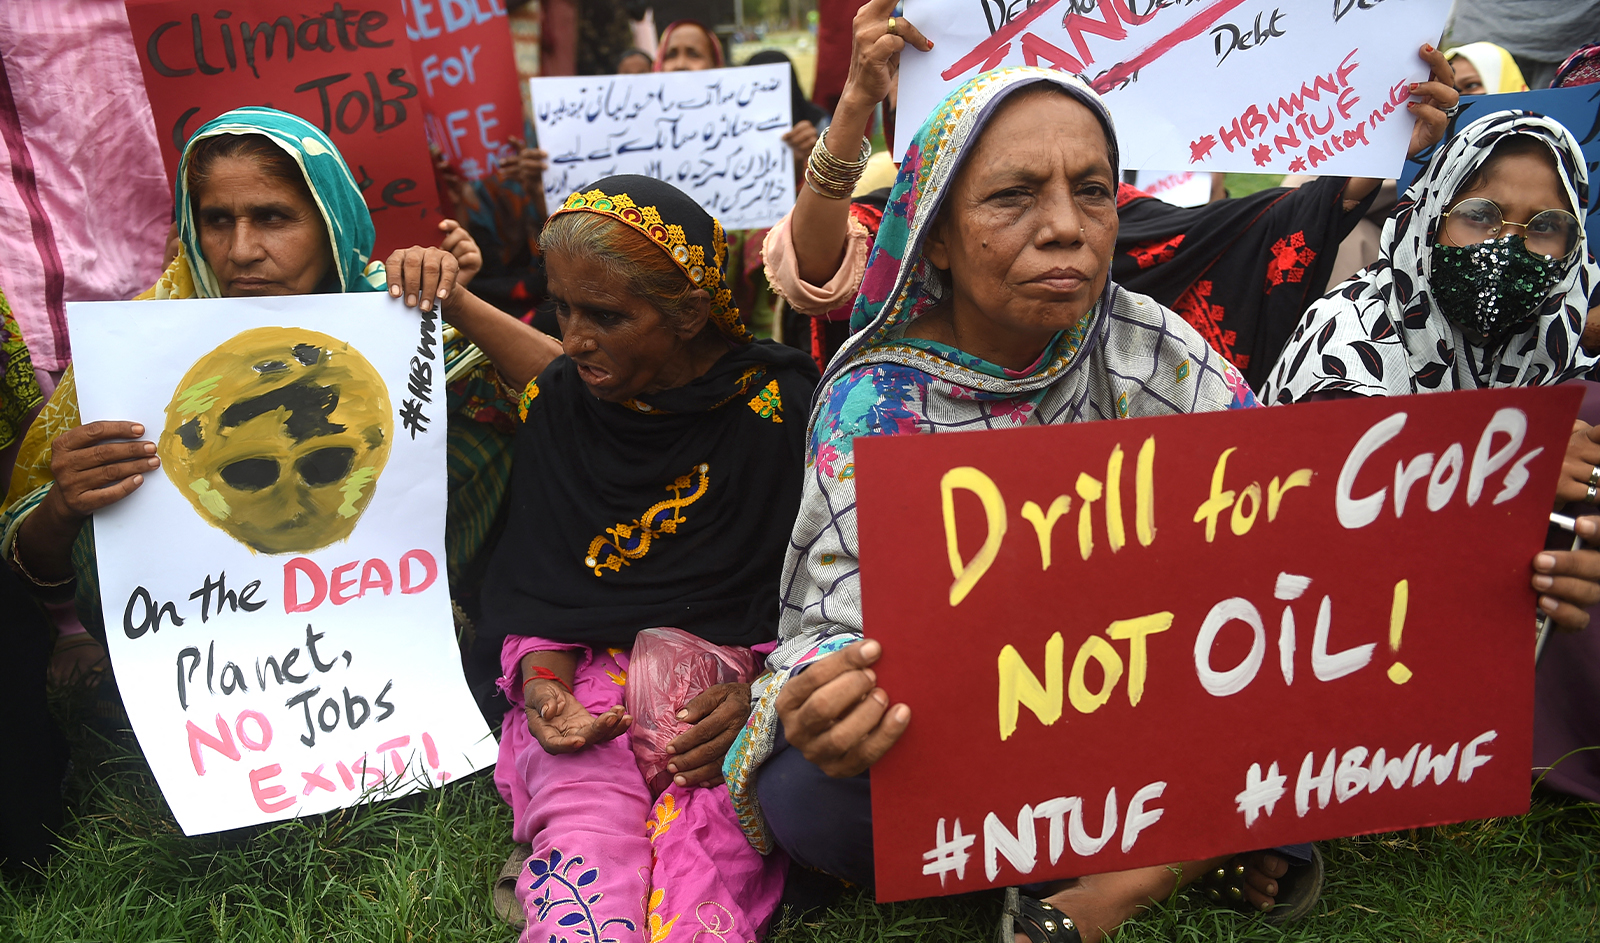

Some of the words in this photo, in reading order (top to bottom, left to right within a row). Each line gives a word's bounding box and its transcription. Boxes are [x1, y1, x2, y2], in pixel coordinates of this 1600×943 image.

[146, 2, 395, 79] Climate
[1209, 7, 1288, 68] Debt
[294, 67, 419, 135] Jobs
[939, 435, 1157, 607] Drill
[1192, 446, 1315, 543] for
[123, 586, 187, 639] On
[188, 570, 267, 624] the
[283, 548, 438, 614] DEAD
[175, 623, 353, 712] Planet,
[997, 610, 1175, 741] NOT
[185, 709, 274, 776] NO
[284, 678, 396, 748] Jobs
[922, 780, 1169, 887] #NTUF
[1235, 729, 1498, 829] #HBWWF
